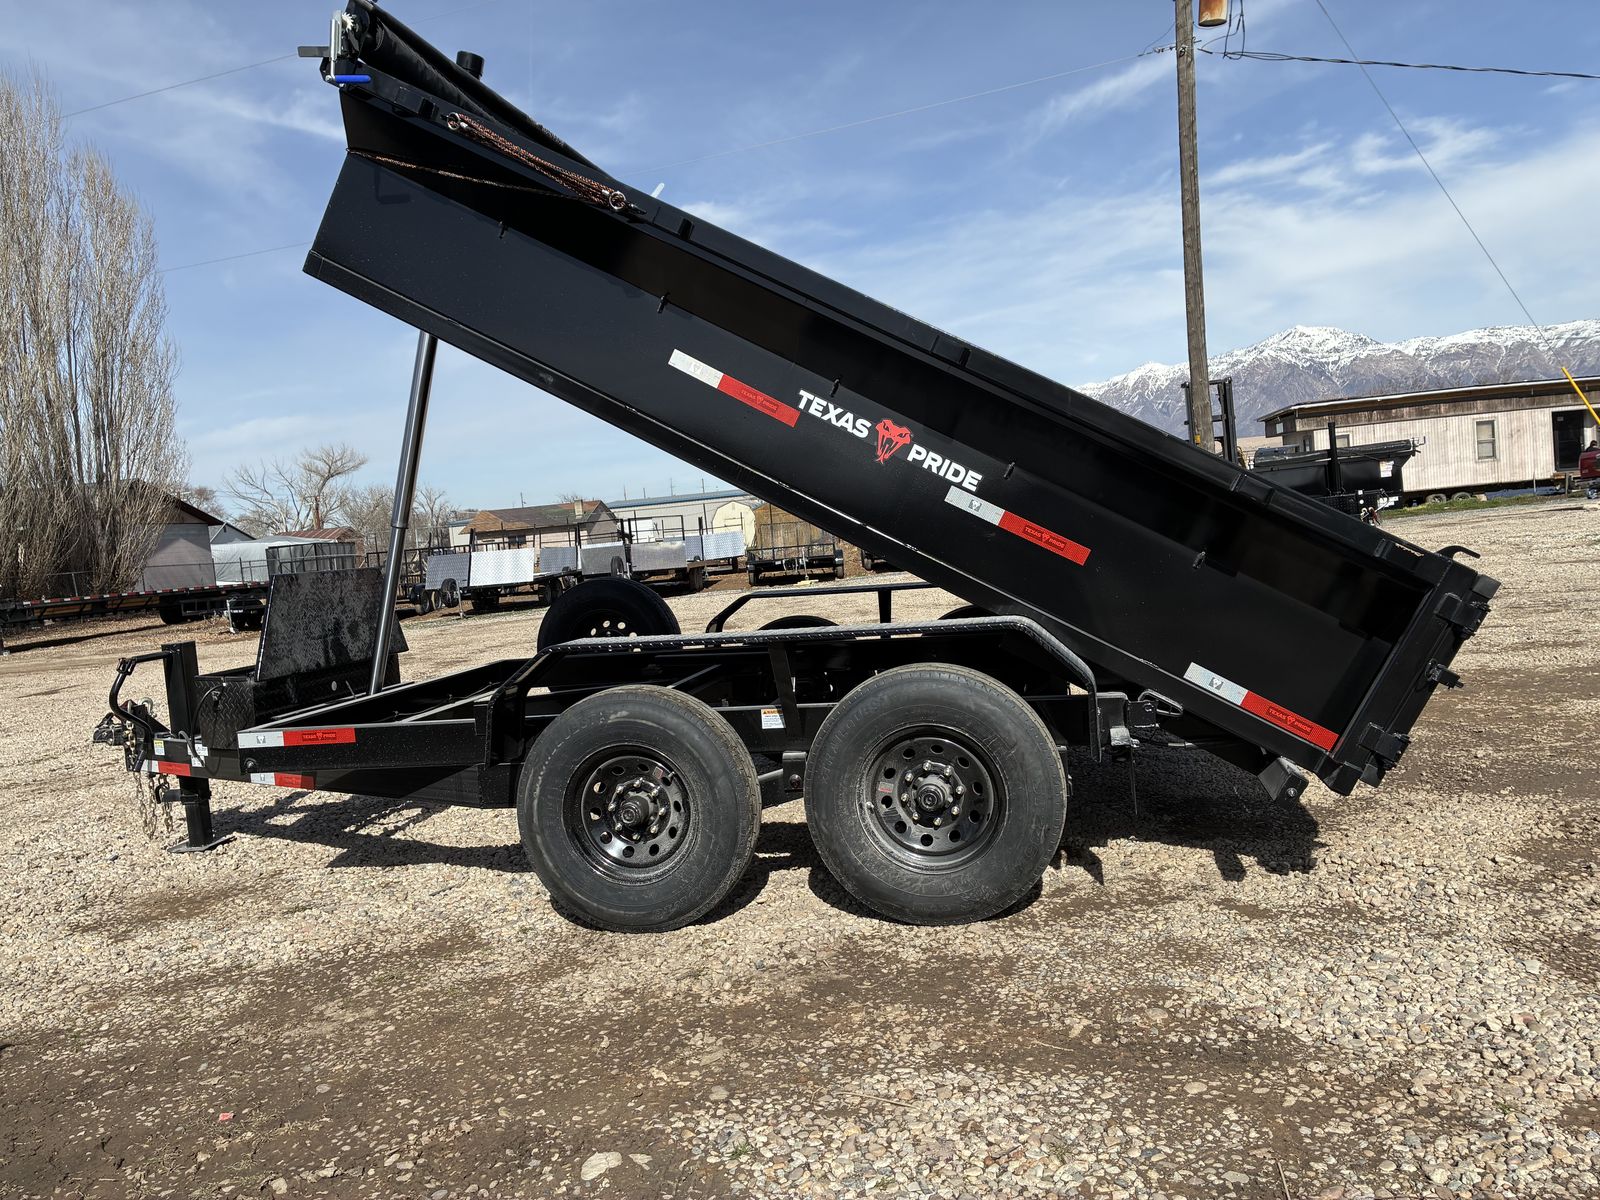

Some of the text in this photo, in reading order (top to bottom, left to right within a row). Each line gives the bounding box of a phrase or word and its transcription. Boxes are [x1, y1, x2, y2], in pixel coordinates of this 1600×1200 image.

[798, 389, 983, 492] TEXAS PRIDE
[1025, 526, 1065, 549] TEXAS PRIDE
[1269, 708, 1286, 720] TEXAS
